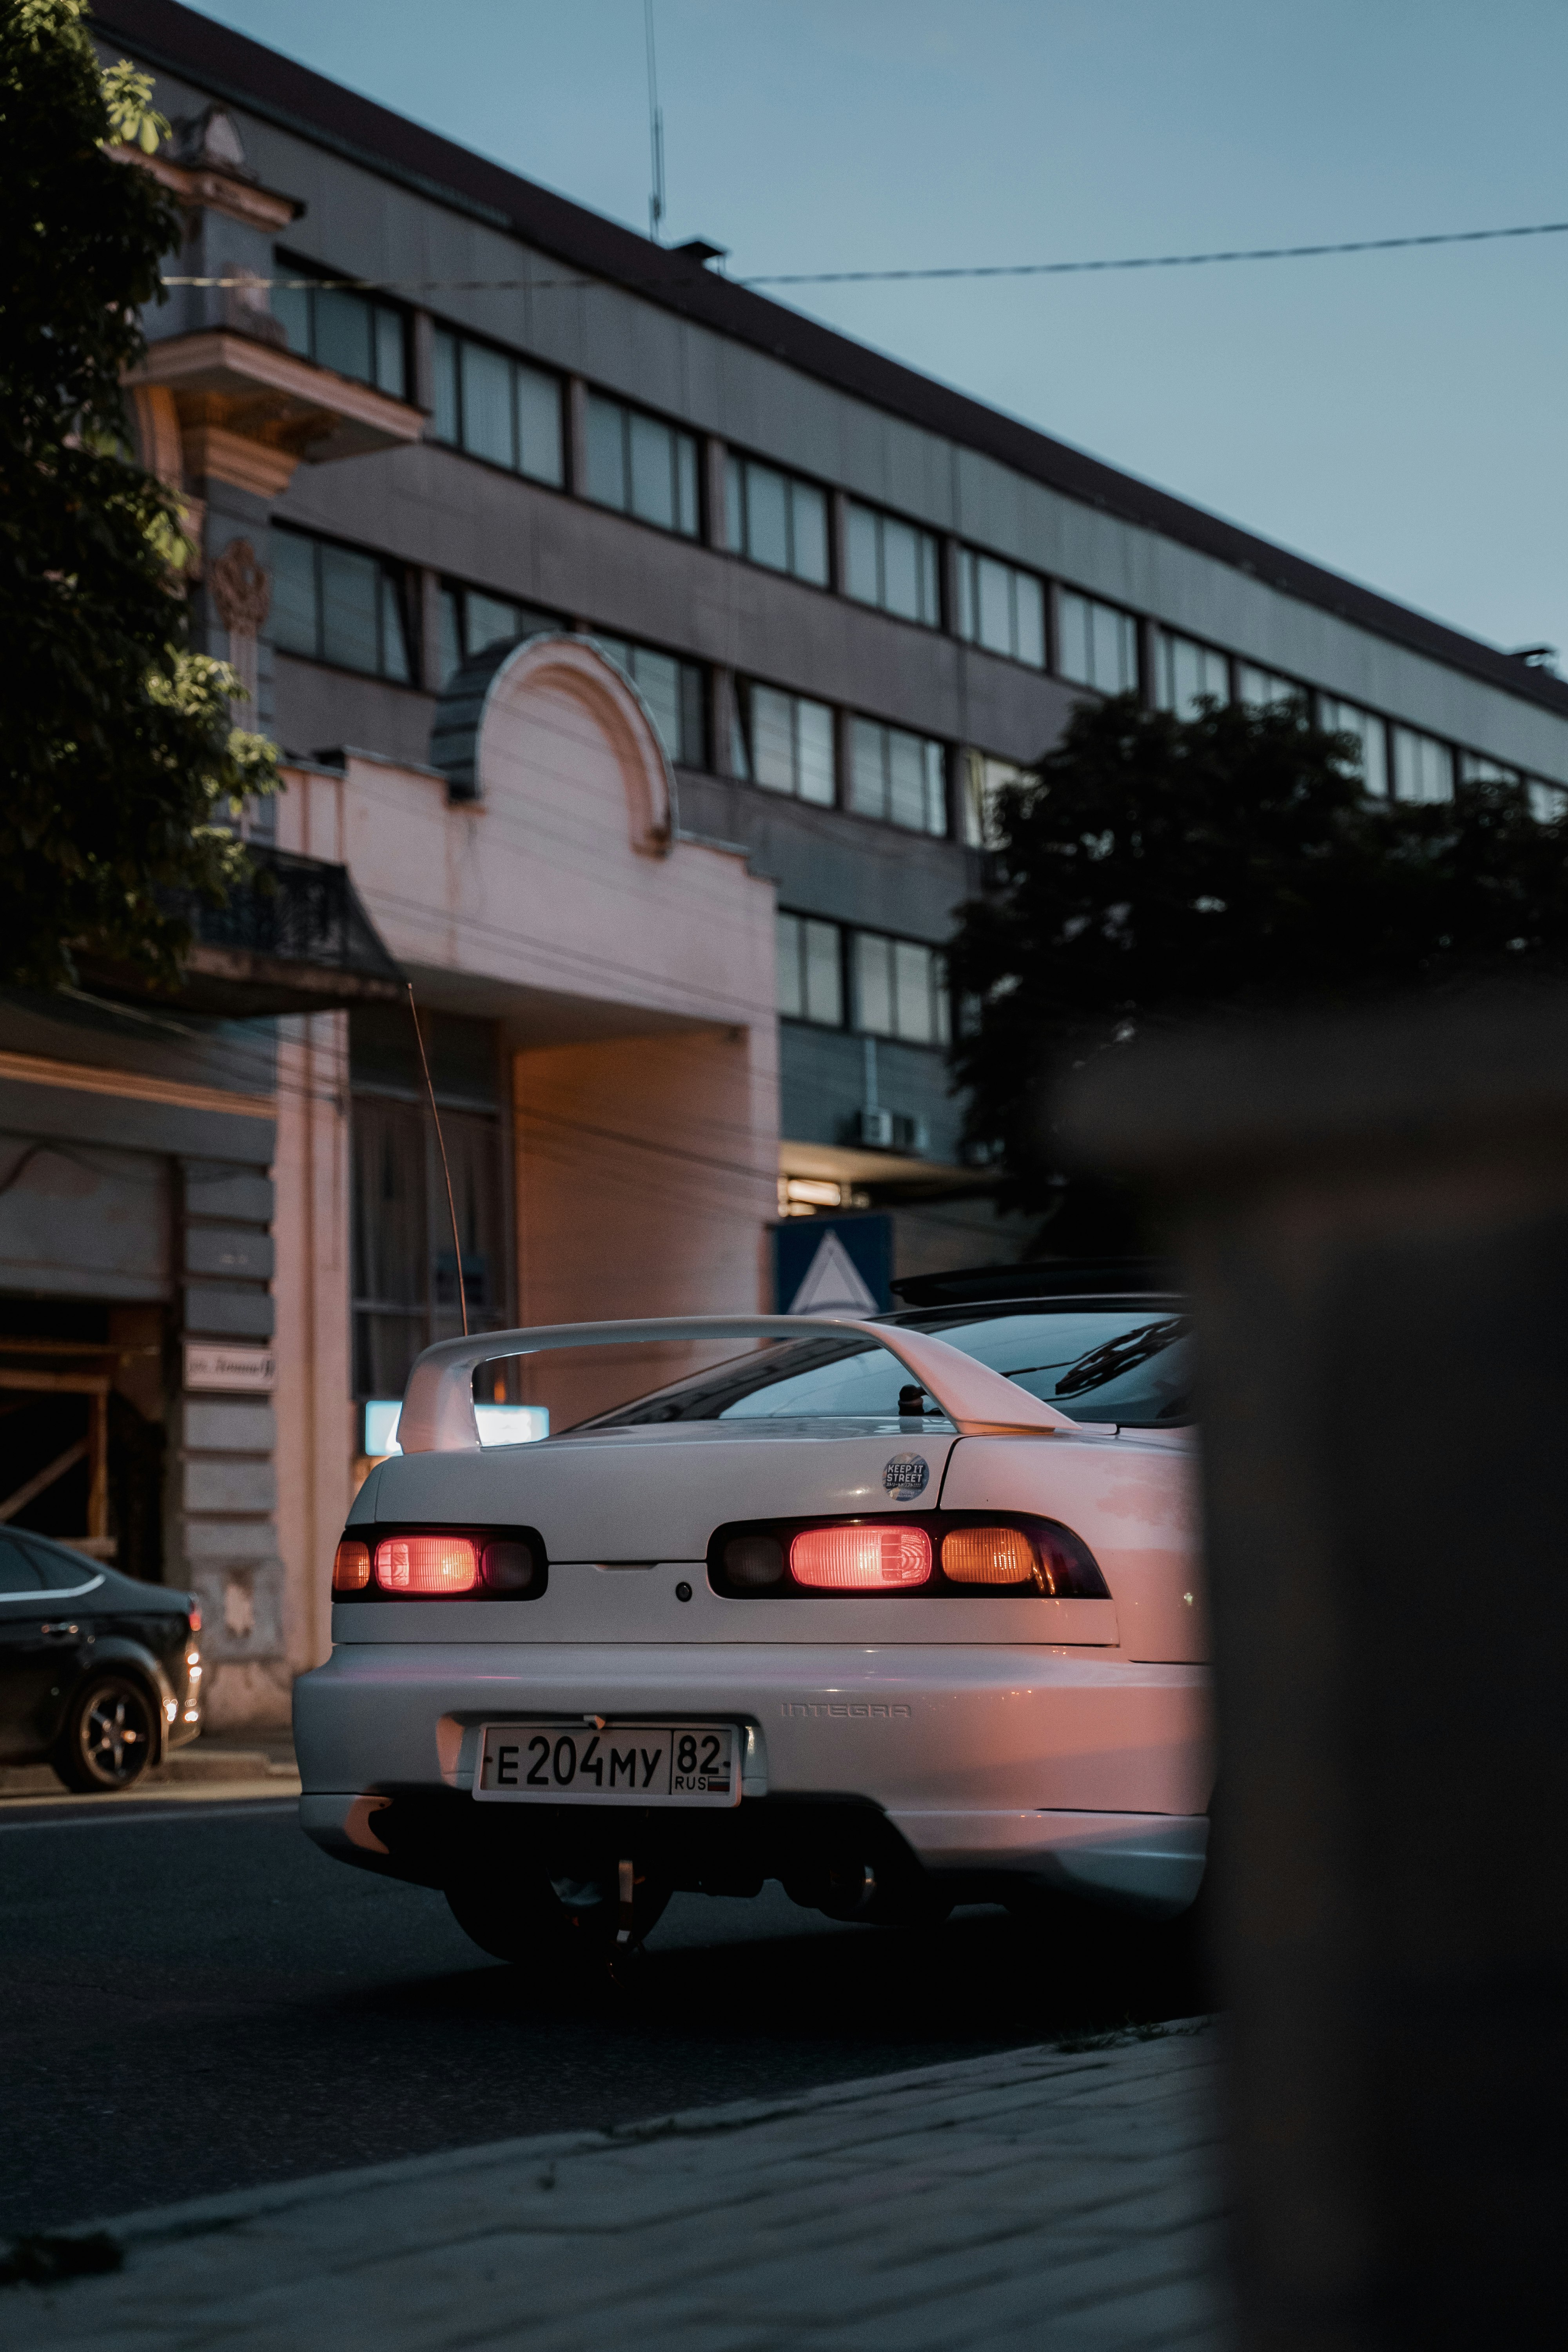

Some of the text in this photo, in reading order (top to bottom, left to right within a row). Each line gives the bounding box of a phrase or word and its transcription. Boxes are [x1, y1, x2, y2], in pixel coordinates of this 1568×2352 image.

[781, 1703, 911, 1718] INTEGRA
[677, 1735, 720, 1774] 82
[675, 1776, 706, 1790] RUS
